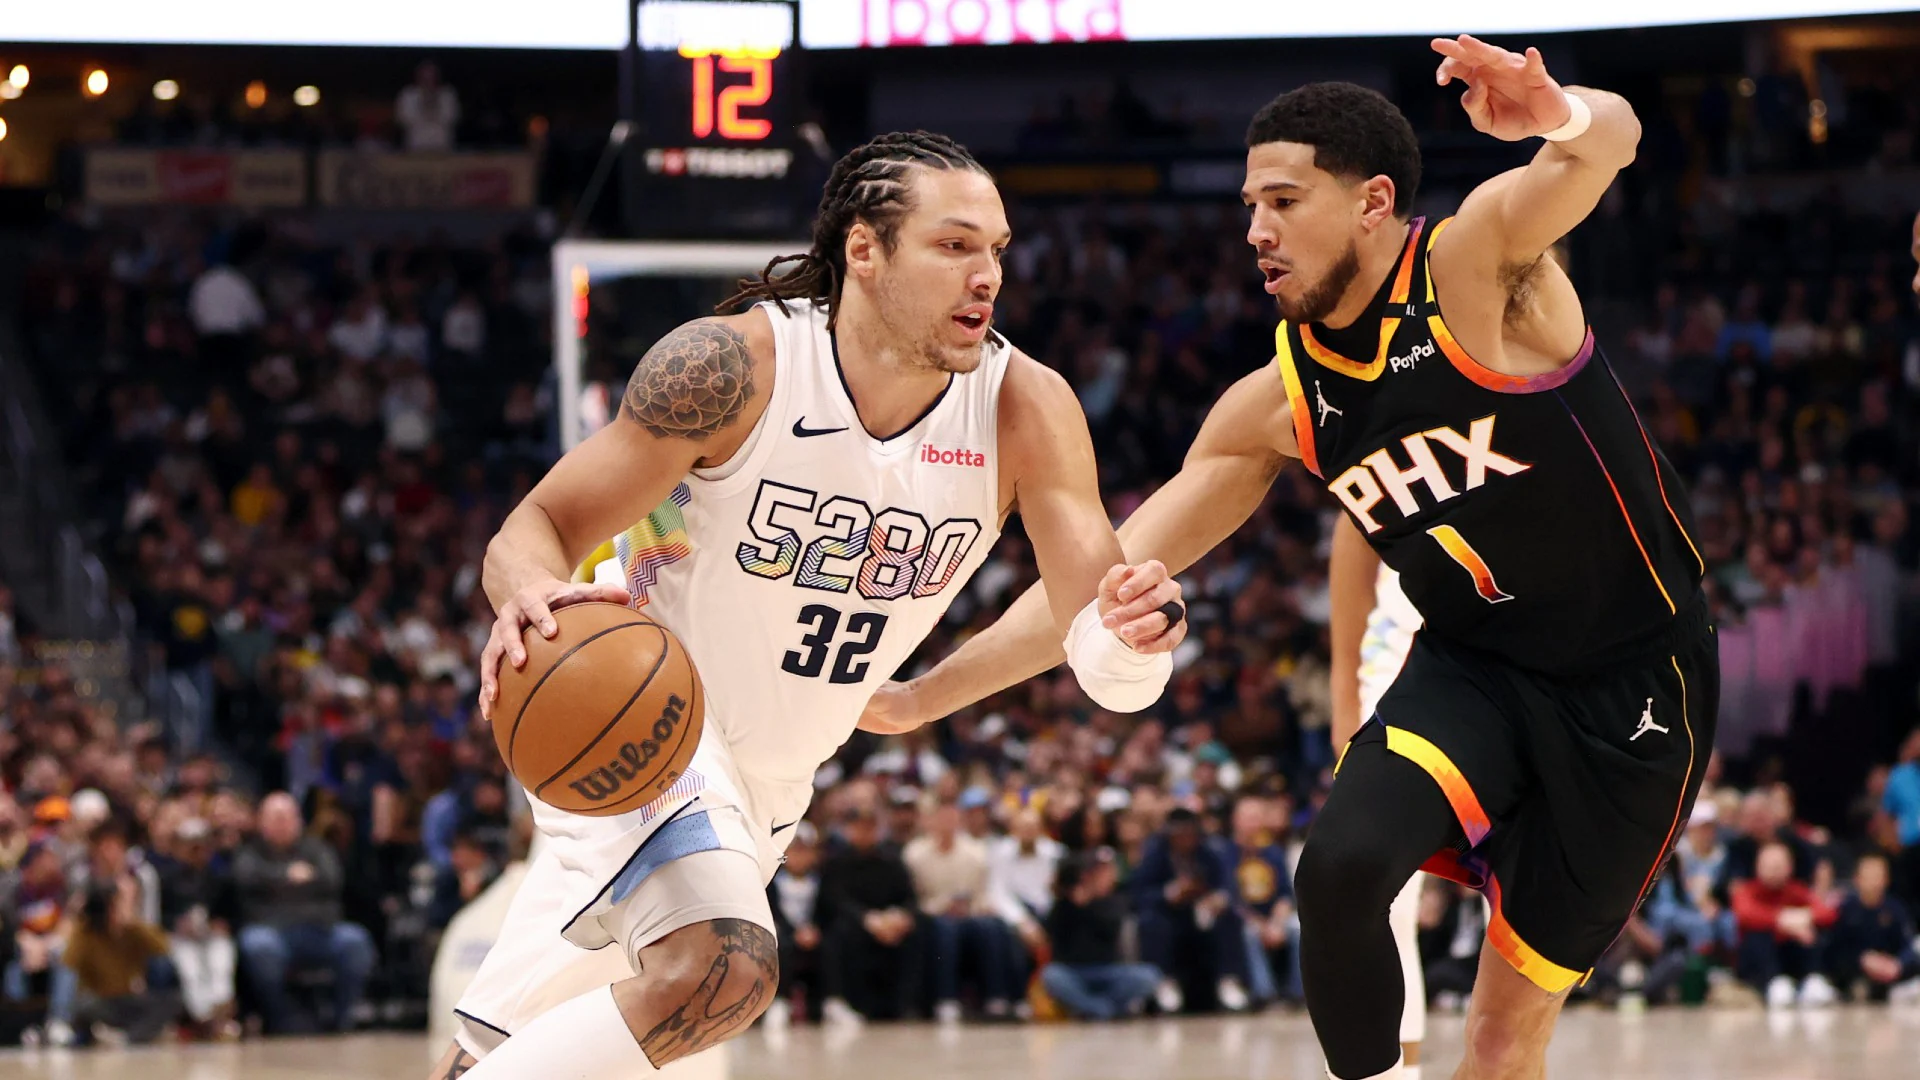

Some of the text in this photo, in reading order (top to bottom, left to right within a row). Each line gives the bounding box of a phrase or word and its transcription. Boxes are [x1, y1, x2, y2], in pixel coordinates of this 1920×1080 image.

[692, 55, 772, 140] 12
[1389, 339, 1435, 373] PayPal
[921, 444, 985, 467] ibotta
[1328, 413, 1534, 534] PHX
[735, 479, 982, 601] 5280
[1426, 524, 1515, 604] 1
[781, 604, 889, 684] 32
[568, 693, 687, 801] Wilson
